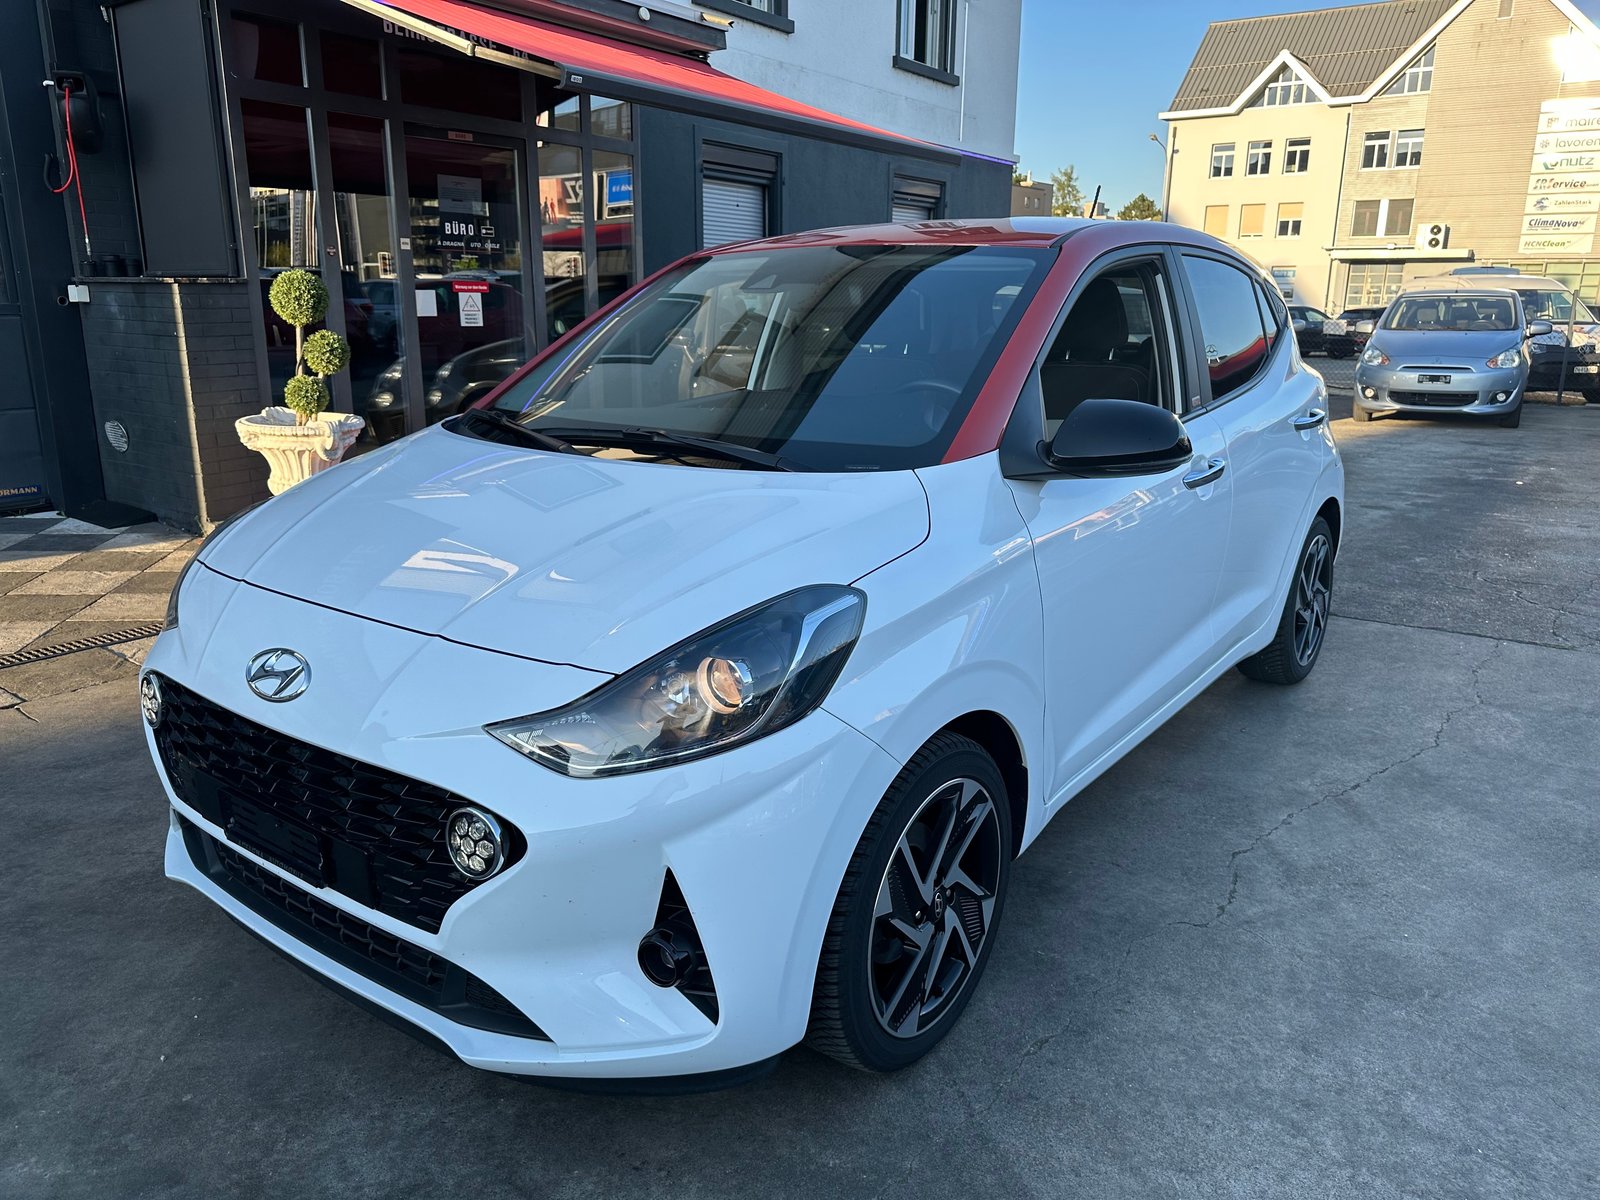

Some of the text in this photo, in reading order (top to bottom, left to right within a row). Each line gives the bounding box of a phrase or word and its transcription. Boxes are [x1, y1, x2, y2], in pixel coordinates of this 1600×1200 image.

[1559, 156, 1594, 167] nutz
[444, 221, 474, 235] BÜRO
[1528, 218, 1579, 228] ClimaNova
